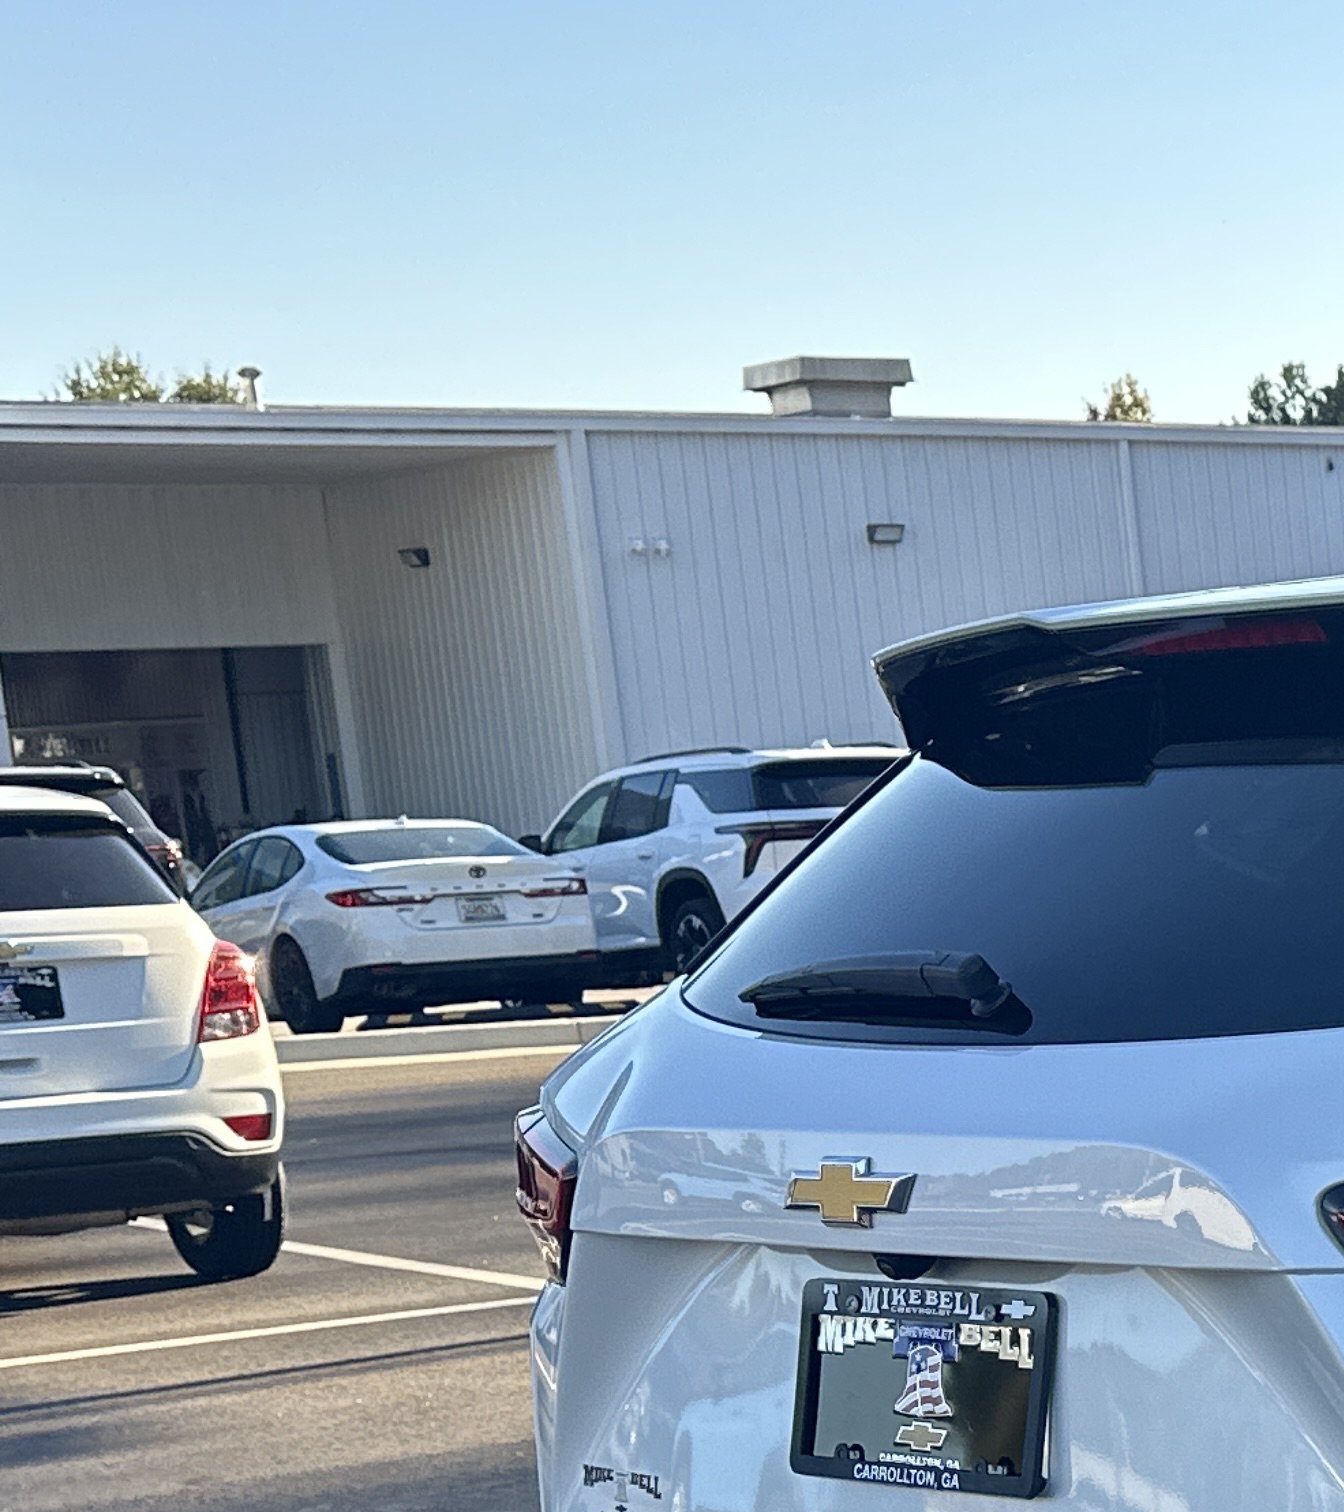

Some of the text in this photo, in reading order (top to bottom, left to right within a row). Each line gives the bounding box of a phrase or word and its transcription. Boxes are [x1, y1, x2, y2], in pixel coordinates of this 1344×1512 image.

[861, 1286, 986, 1321] MIKE BELL
[890, 1305, 951, 1317] CHEVROLET
[817, 1314, 1034, 1370] MIKE BELL
[899, 1326, 956, 1341] CHEVROLET
[583, 1464, 662, 1500] MIKE BELL
[853, 1463, 960, 1489] CARROLLTON, GA
